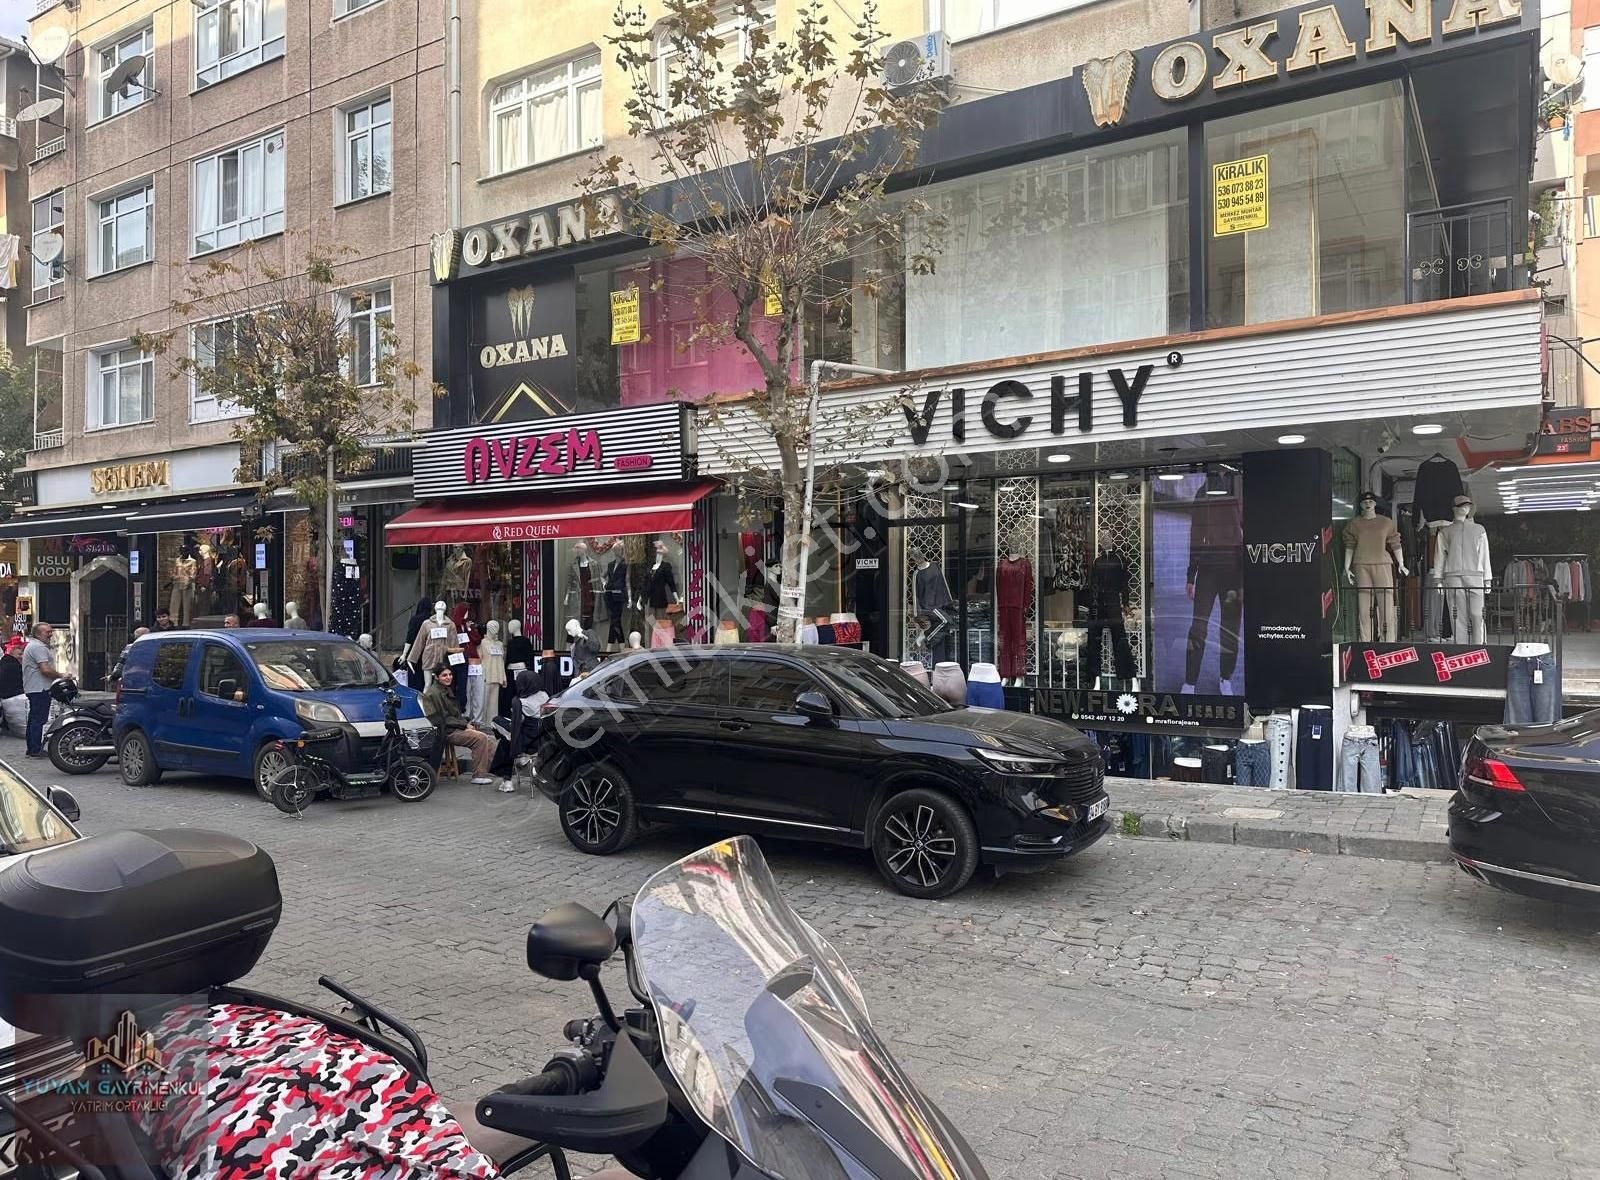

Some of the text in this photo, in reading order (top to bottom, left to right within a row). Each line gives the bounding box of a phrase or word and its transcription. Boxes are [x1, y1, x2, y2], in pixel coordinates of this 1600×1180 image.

[1217, 178, 1264, 197] 536 073 88 23
[1217, 191, 1264, 210] 530 945 54 89
[480, 334, 569, 369] OXANA
[901, 364, 1155, 446] VICHY
[1540, 415, 1591, 436] ABS
[1560, 435, 1589, 443] FASHION
[616, 457, 648, 468] FASHION
[504, 524, 560, 537] RED QUEEN
[37, 555, 70, 566] USLU
[1246, 542, 1316, 564] VICHY
[32, 566, 73, 577] MODA
[1364, 650, 1382, 679] RED
[1379, 650, 1415, 667] STOP!
[1432, 652, 1451, 681] RED
[1449, 652, 1486, 669] STOP!
[1187, 704, 1236, 720] JEANS
